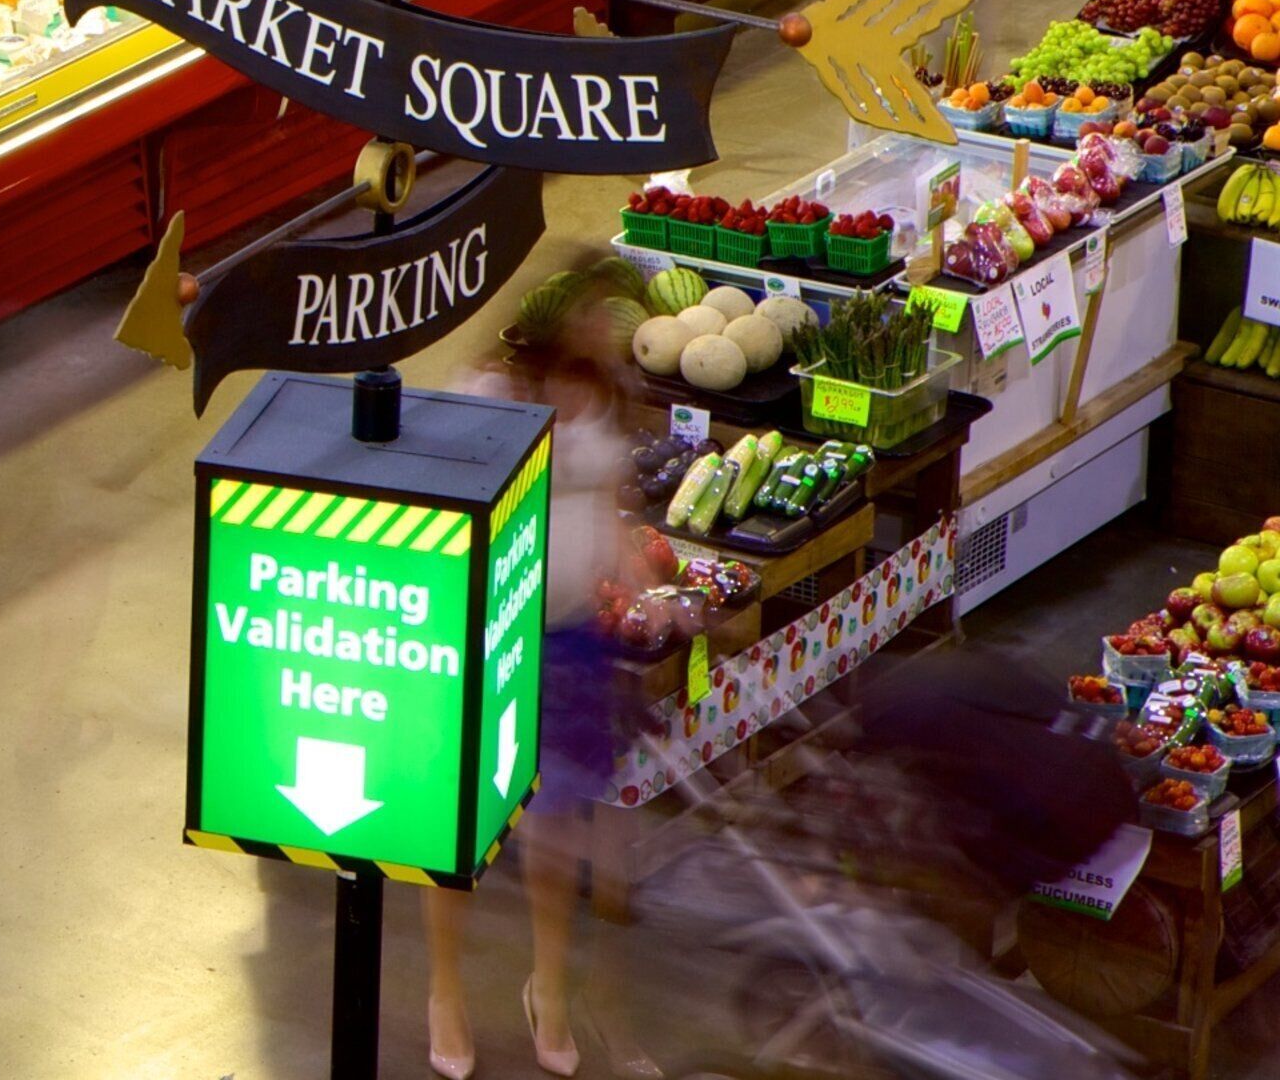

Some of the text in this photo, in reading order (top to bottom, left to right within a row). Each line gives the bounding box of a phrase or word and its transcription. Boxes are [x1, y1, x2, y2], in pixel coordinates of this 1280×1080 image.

[404, 53, 667, 148] SQUARE
[289, 223, 488, 347] PARKING
[1030, 273, 1054, 296] LOCAL
[249, 553, 430, 626] Parking
[493, 514, 536, 596] Parking
[215, 602, 459, 678] Validation
[484, 559, 543, 661] Validation
[280, 669, 388, 722] Here
[497, 636, 523, 689] Here
